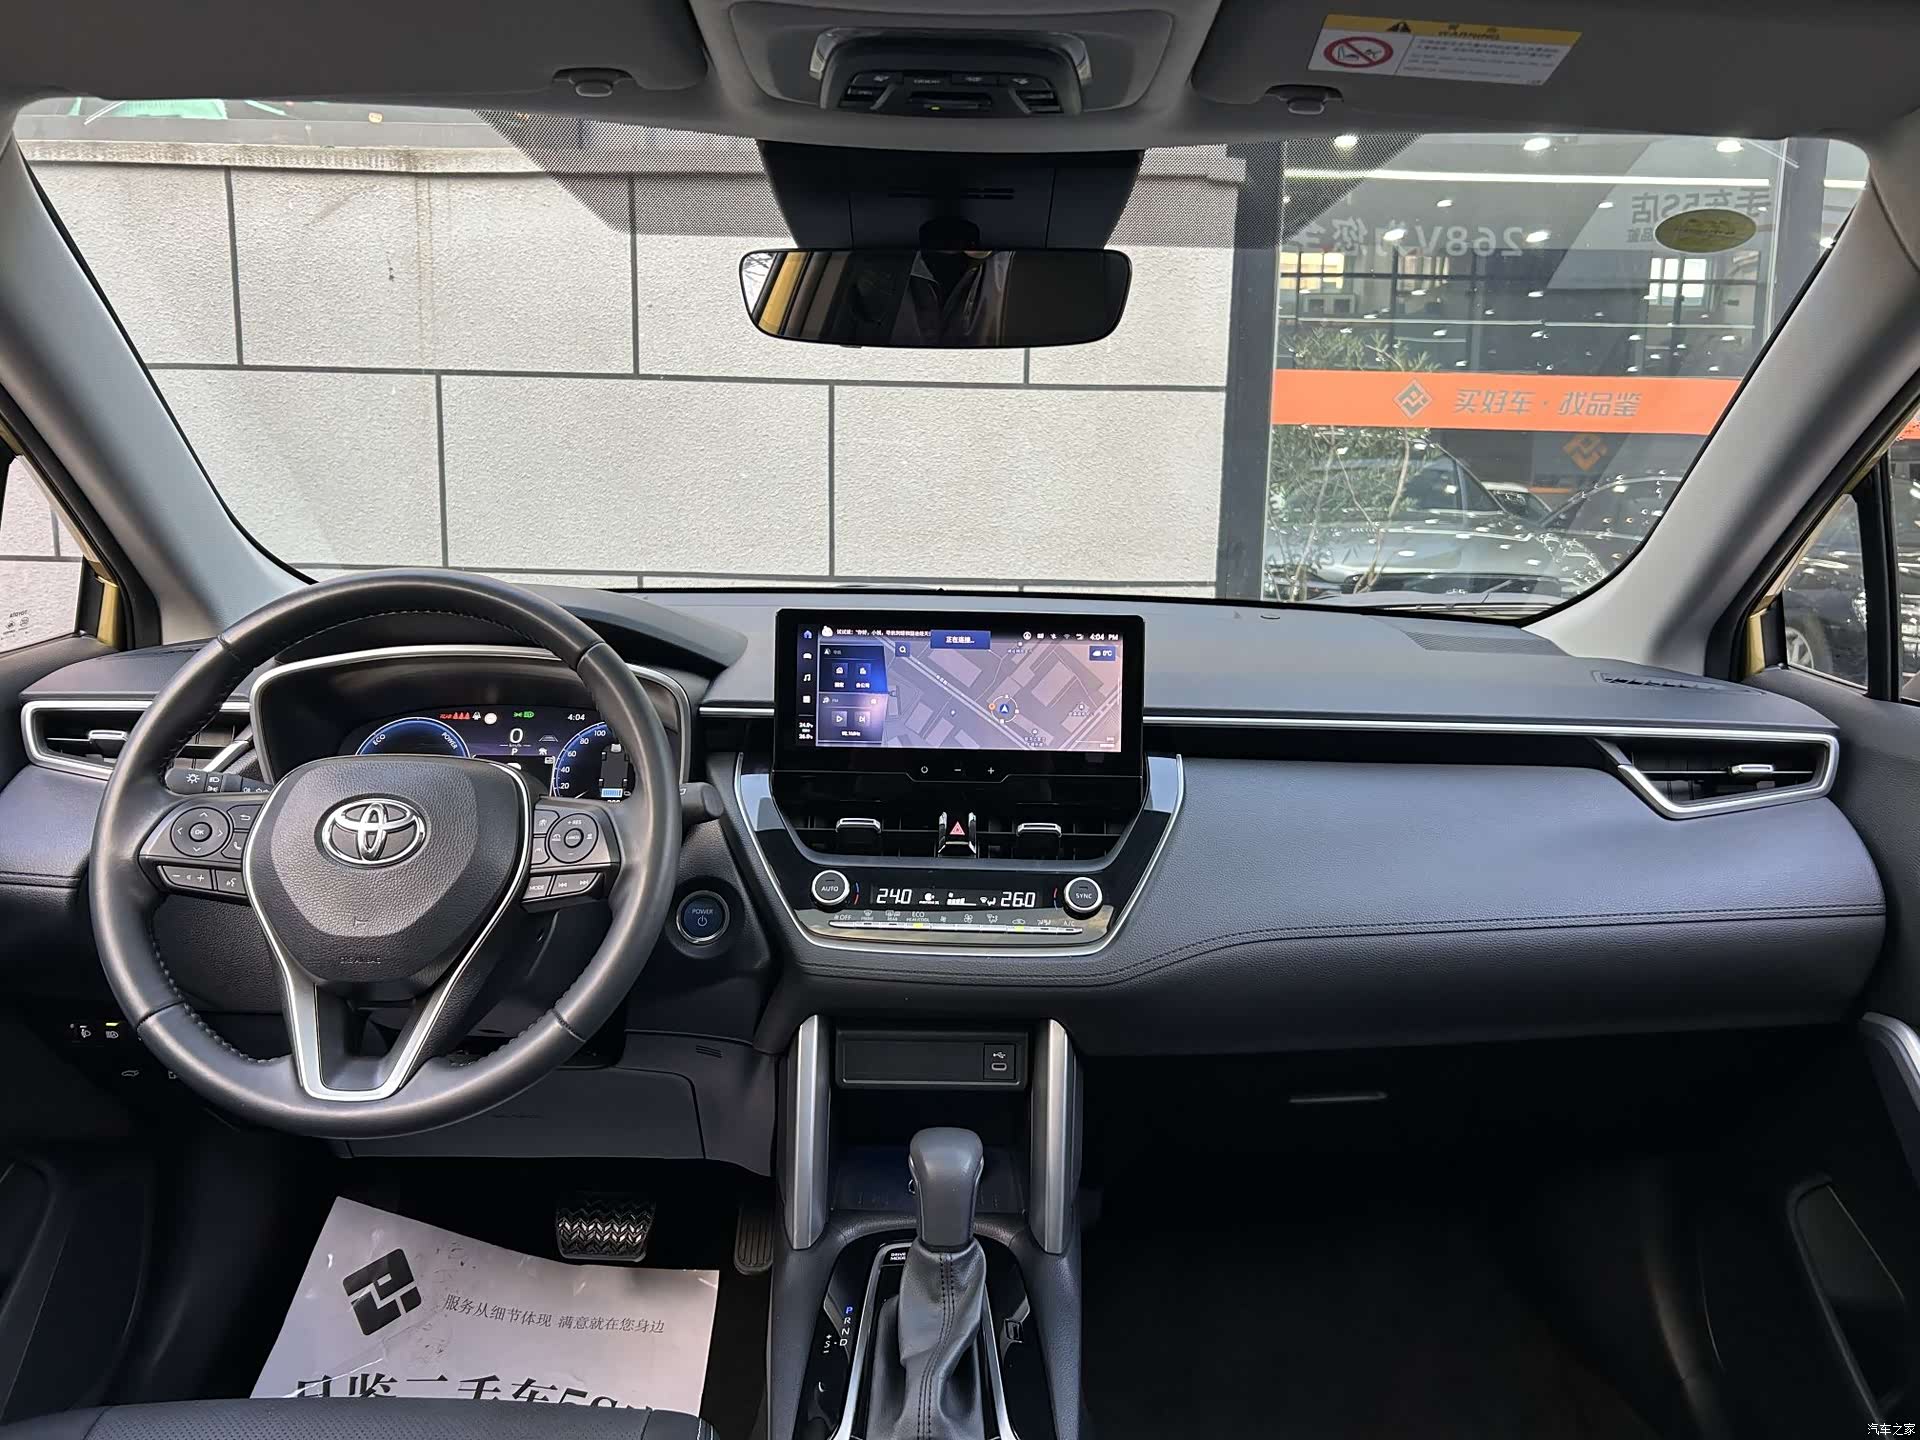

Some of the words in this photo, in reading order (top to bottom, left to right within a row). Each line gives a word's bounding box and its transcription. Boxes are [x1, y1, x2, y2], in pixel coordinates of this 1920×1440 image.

[1089, 633, 1105, 641] 4:04
[567, 713, 586, 721] 4:04
[509, 727, 524, 744] 0
[372, 733, 387, 747] ECO
[440, 732, 459, 751] POWER
[511, 747, 519, 756] P
[567, 750, 577, 758] 60
[560, 766, 571, 774] 40
[560, 782, 570, 790] 20
[194, 828, 205, 836] OK
[529, 883, 545, 891] MODE
[820, 885, 839, 893] AUTO
[1075, 892, 1093, 900] SYNC
[441, 1293, 554, 1329] 服务从细节体现
[557, 1314, 666, 1335] 满意就在您身边
[845, 1306, 854, 1315] P
[843, 1316, 852, 1325] R
[841, 1327, 851, 1336] N
[823, 1340, 832, 1349] S
[839, 1338, 849, 1347] D
